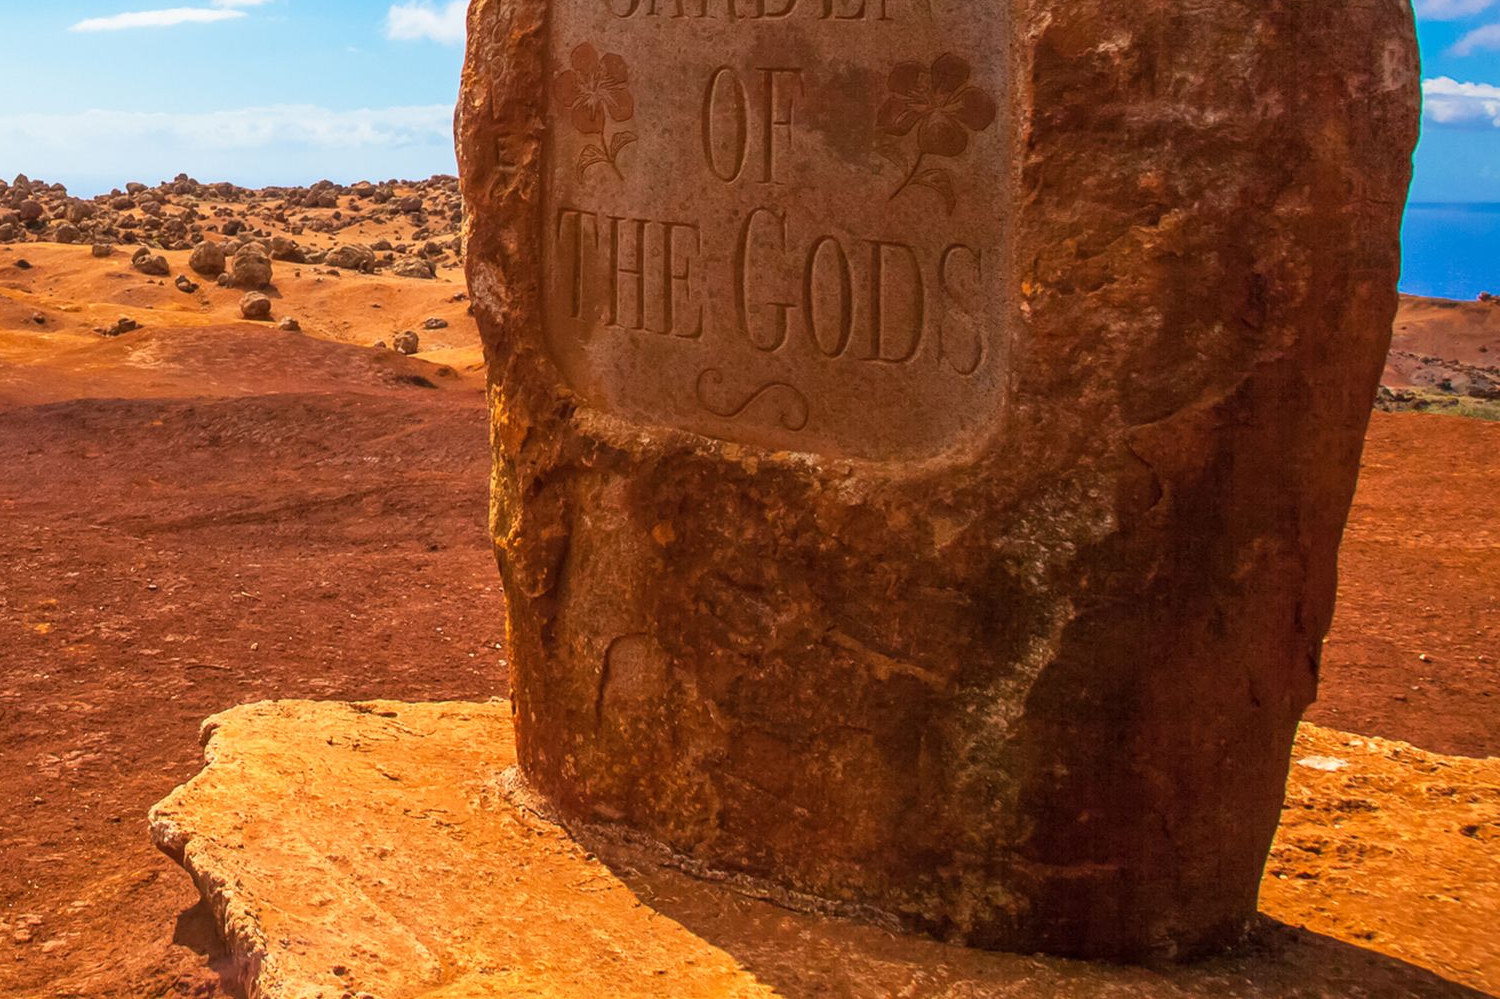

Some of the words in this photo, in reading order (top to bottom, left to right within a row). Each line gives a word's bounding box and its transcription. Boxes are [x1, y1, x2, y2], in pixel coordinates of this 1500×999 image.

[706, 64, 801, 185] OF
[557, 207, 703, 339] THE
[735, 207, 989, 377] GODS
